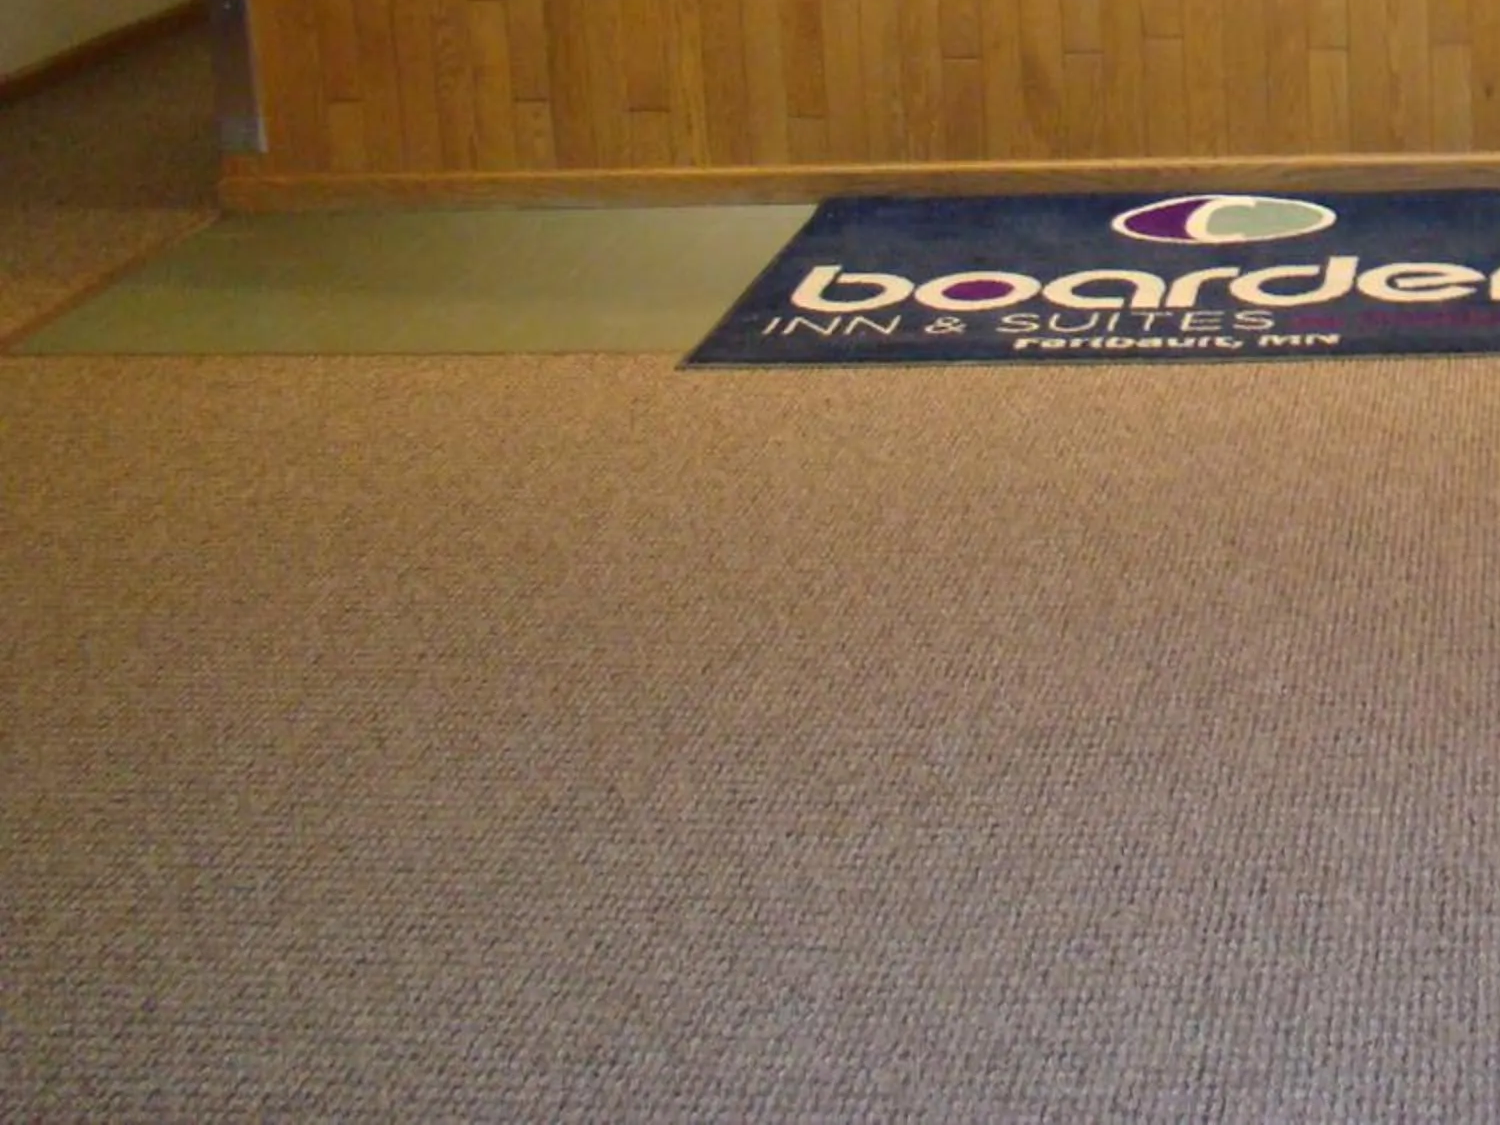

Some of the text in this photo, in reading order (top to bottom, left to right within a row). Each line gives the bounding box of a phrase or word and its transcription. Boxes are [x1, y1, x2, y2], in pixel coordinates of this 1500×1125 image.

[762, 315, 902, 336] INN
[924, 316, 967, 334] &
[996, 309, 1276, 334] SUITES
